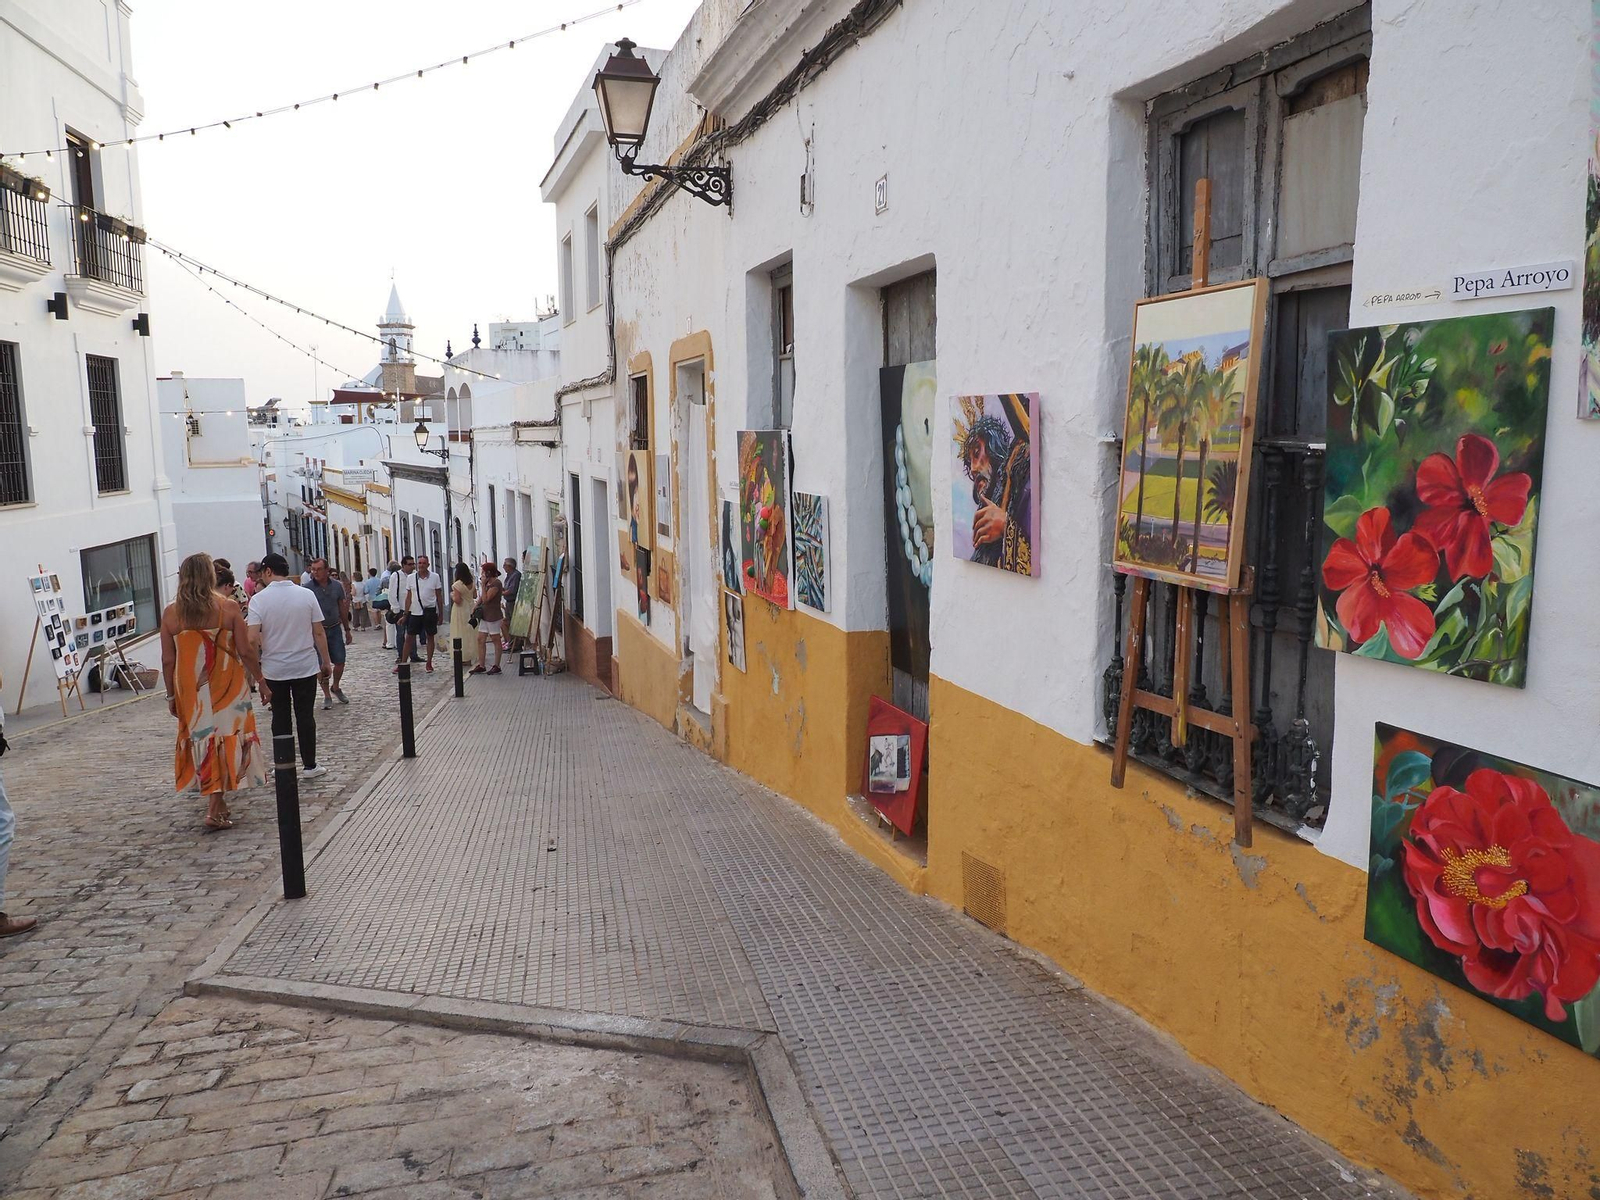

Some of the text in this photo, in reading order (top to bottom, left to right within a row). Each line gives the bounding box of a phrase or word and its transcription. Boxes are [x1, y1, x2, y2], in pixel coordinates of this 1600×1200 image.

[877, 181, 885, 207] 21
[1453, 268, 1569, 297] Pepa Arroyo
[1371, 292, 1422, 307] PEPA ARROYO
